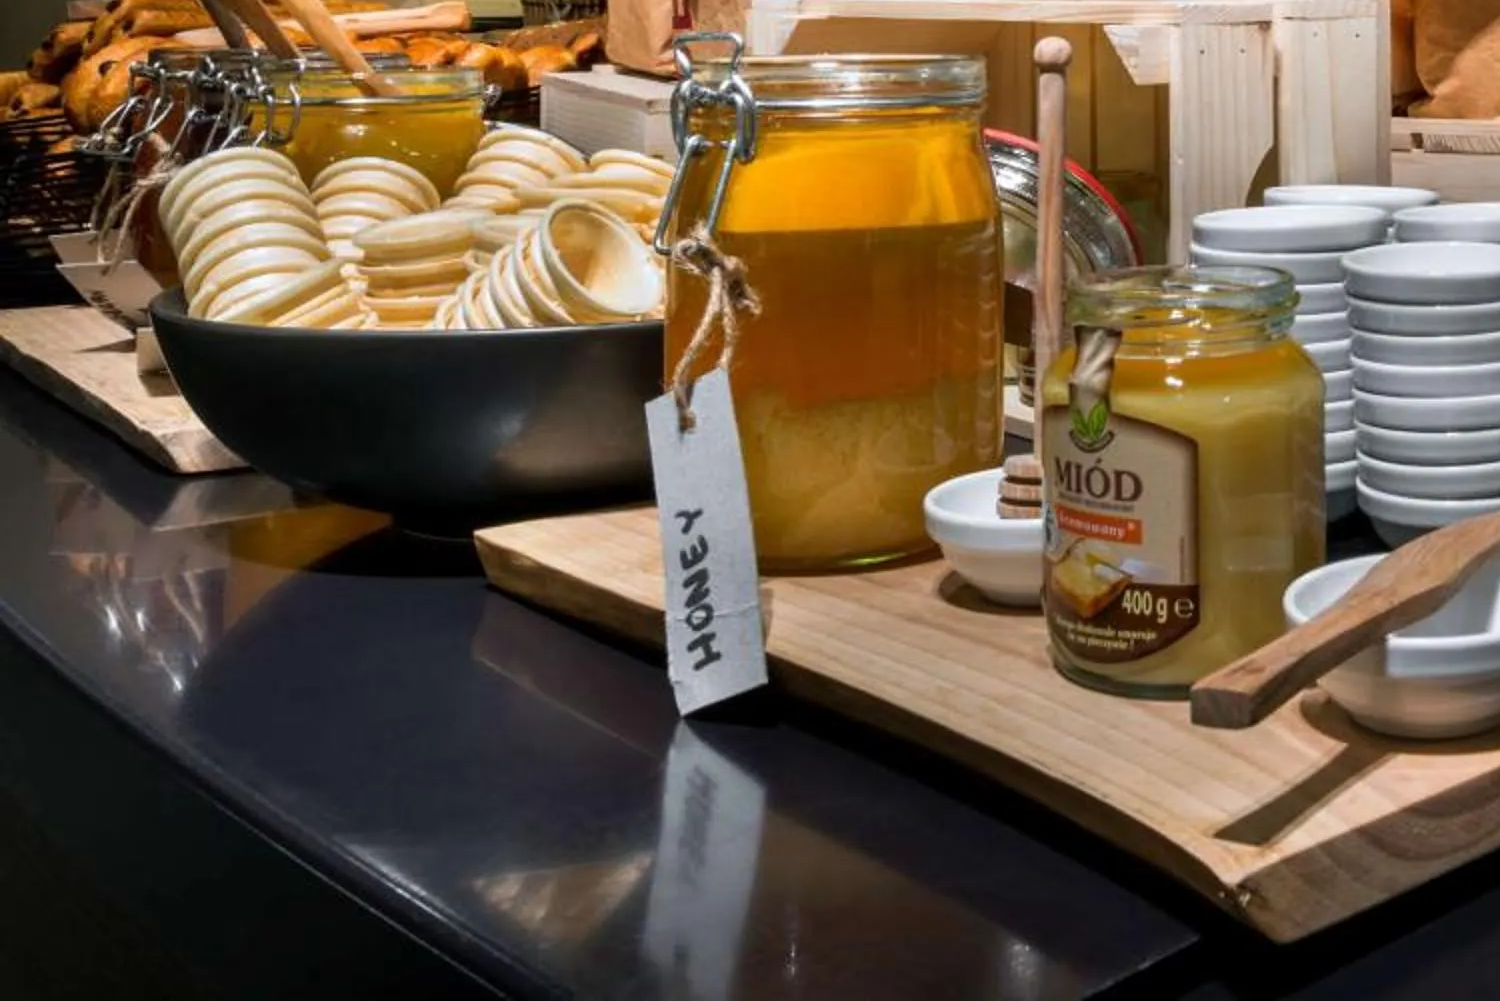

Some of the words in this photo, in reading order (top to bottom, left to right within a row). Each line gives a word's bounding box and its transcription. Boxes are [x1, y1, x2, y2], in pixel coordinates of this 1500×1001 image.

[1053, 456, 1144, 502] MIÓD
[675, 508, 723, 671] HONEY
[1121, 589, 1153, 617] 400
[1155, 596, 1168, 624] g
